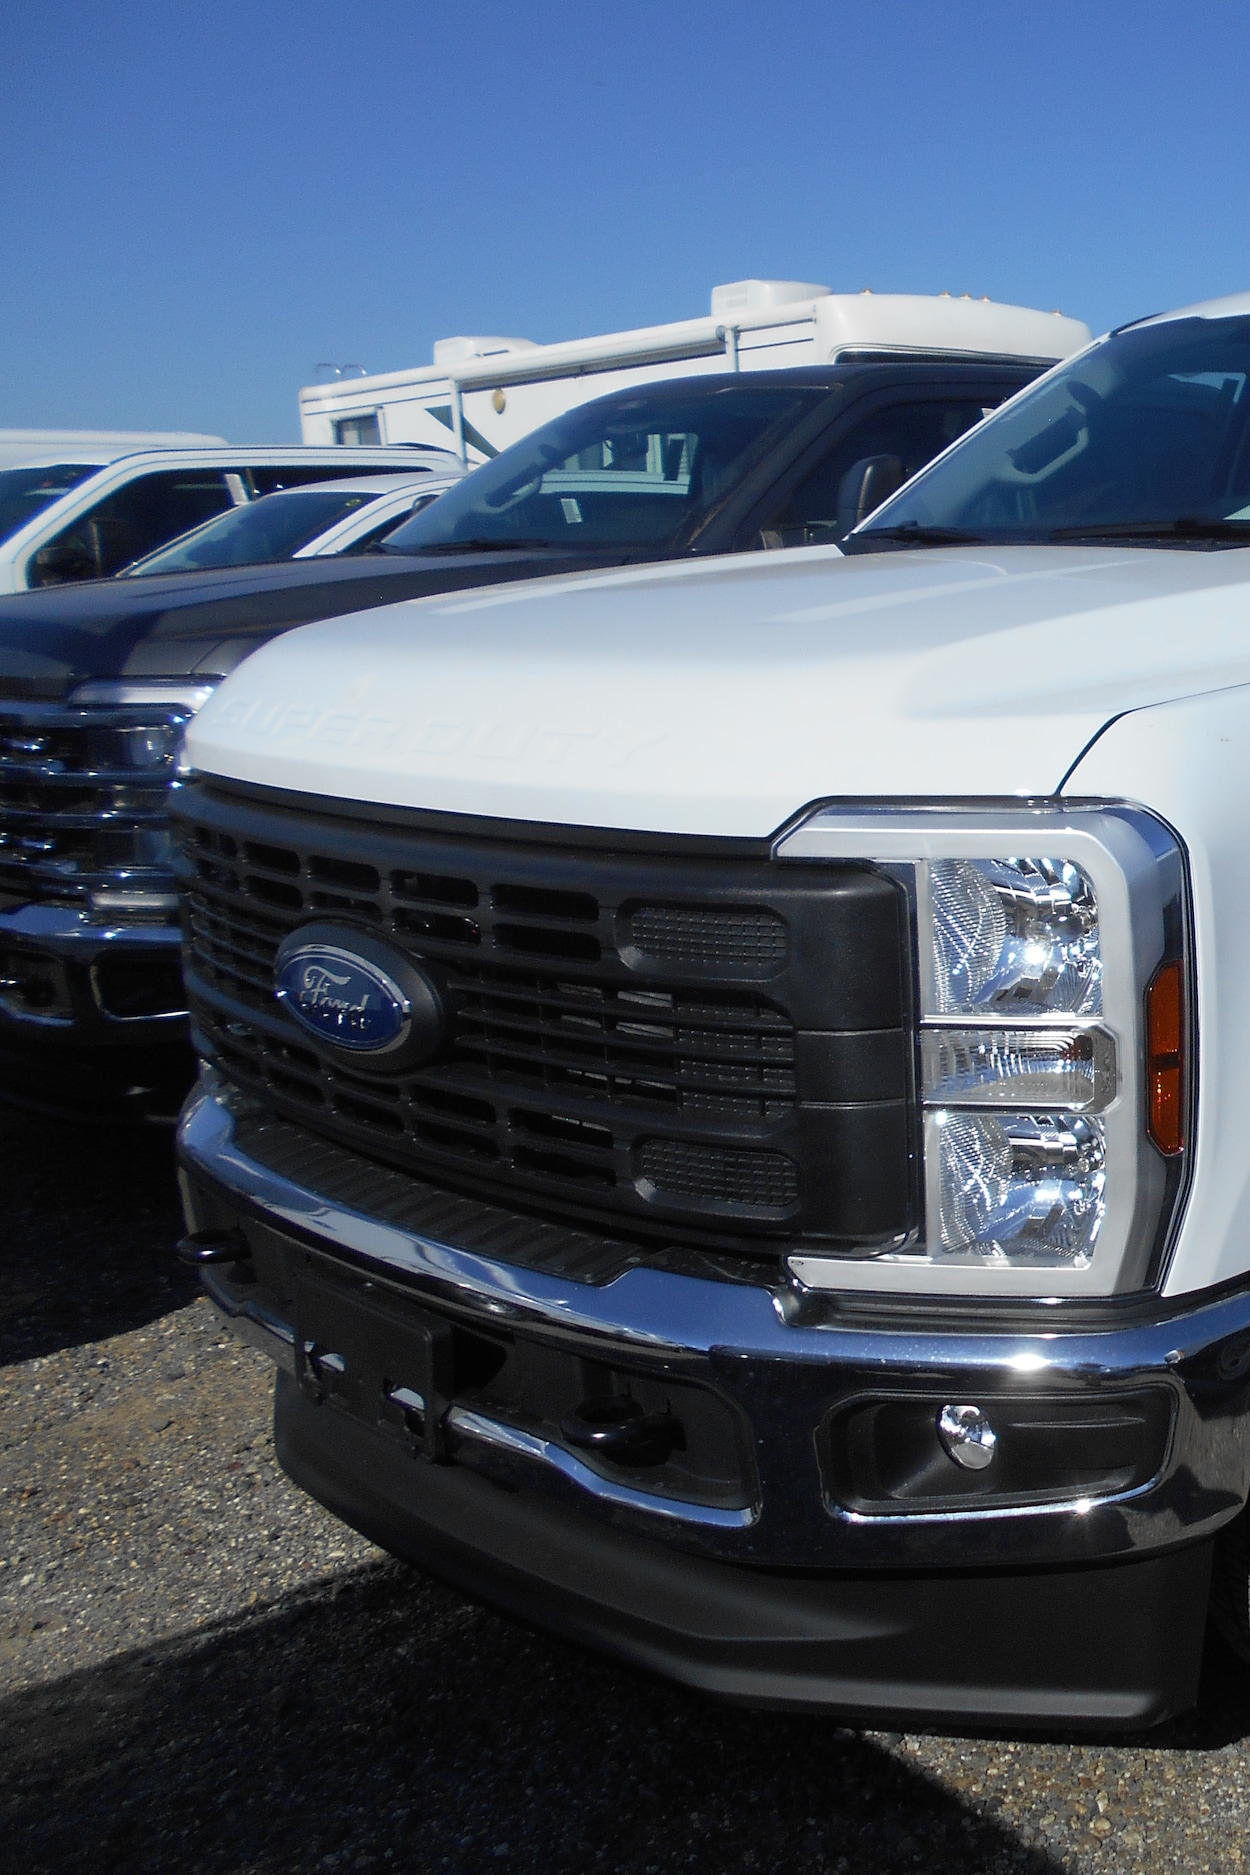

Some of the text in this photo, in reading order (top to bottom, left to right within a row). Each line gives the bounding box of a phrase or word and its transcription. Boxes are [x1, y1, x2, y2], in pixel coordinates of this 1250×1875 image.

[212, 698, 667, 769] SUPER DUTY
[301, 966, 371, 1026] Ford
